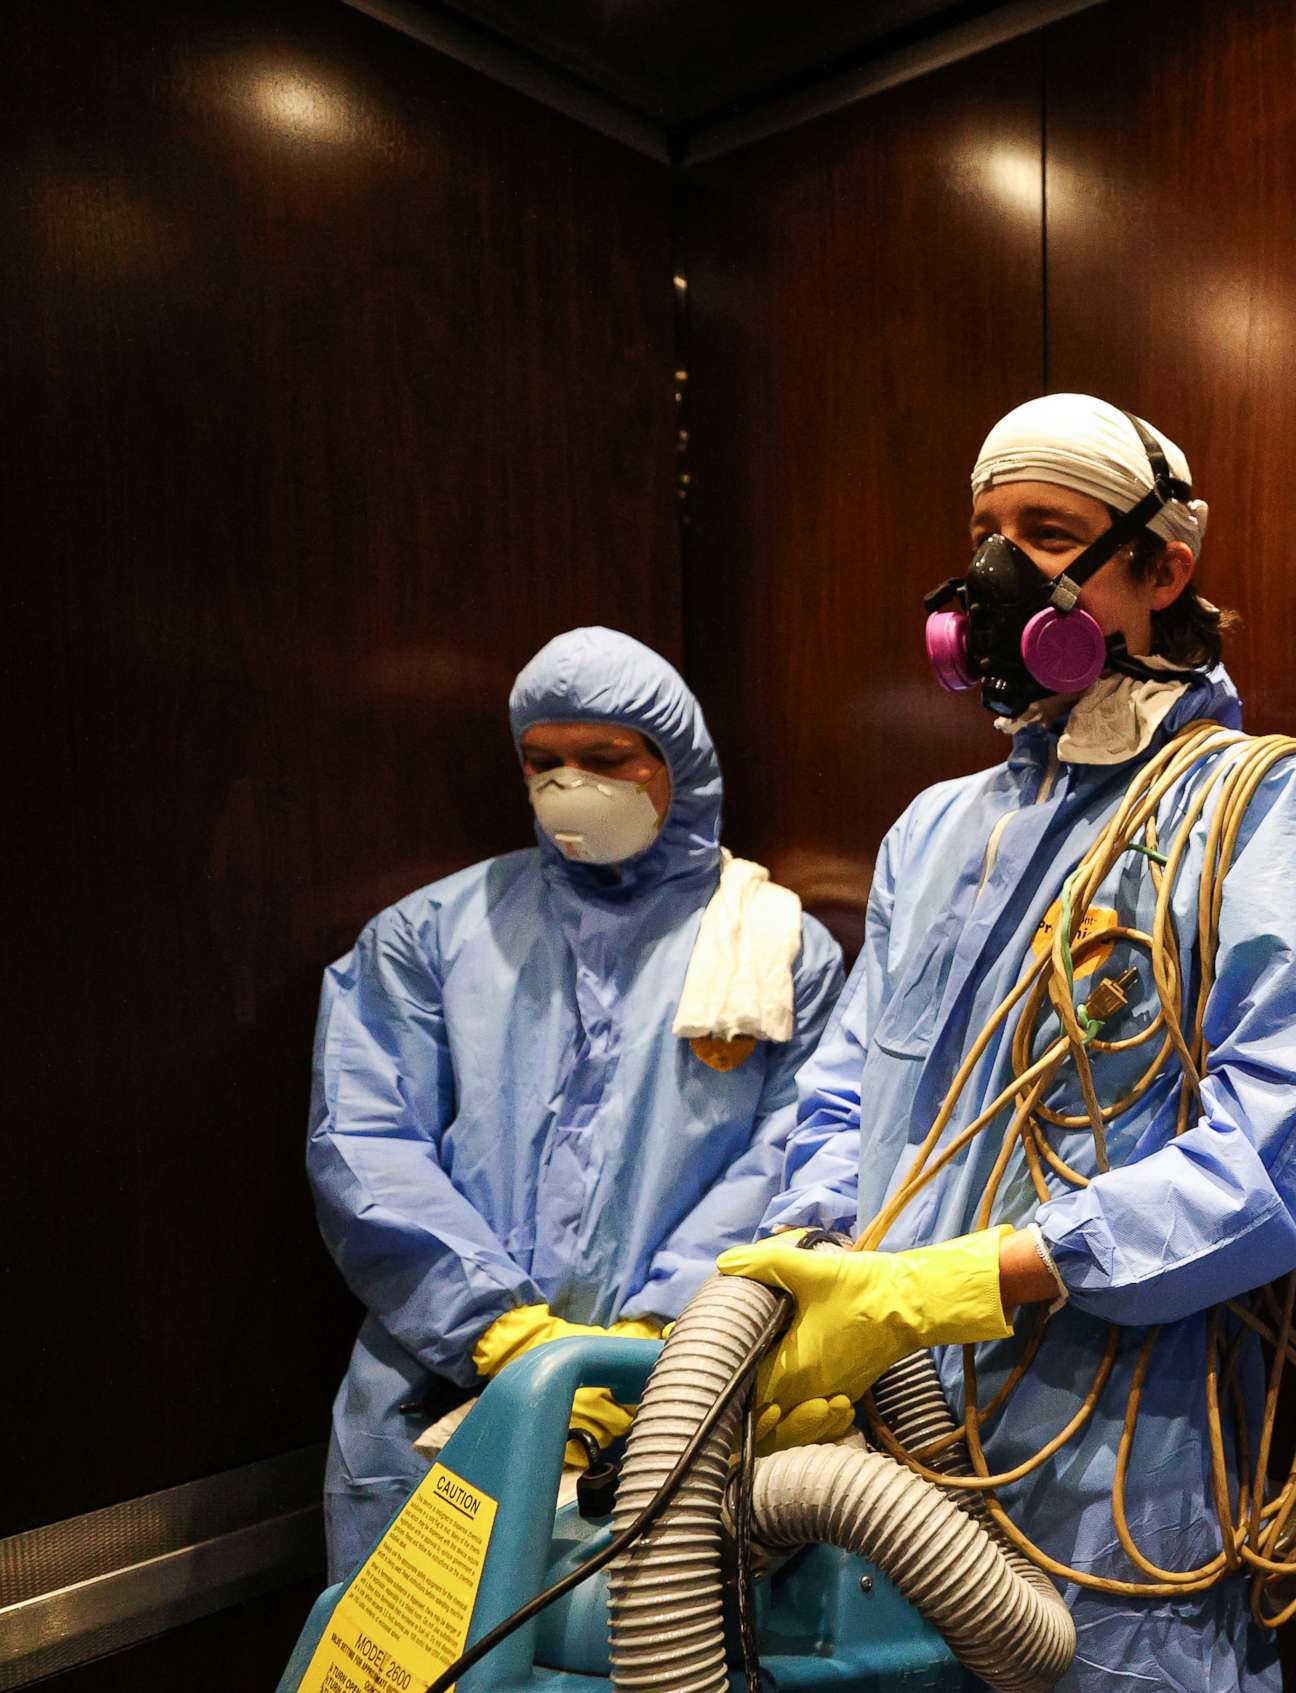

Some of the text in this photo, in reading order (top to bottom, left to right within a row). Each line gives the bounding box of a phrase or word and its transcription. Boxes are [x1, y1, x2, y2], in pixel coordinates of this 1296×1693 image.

[437, 1476, 480, 1514] CAUTION
[355, 1632, 412, 1690] MODEL 2600
